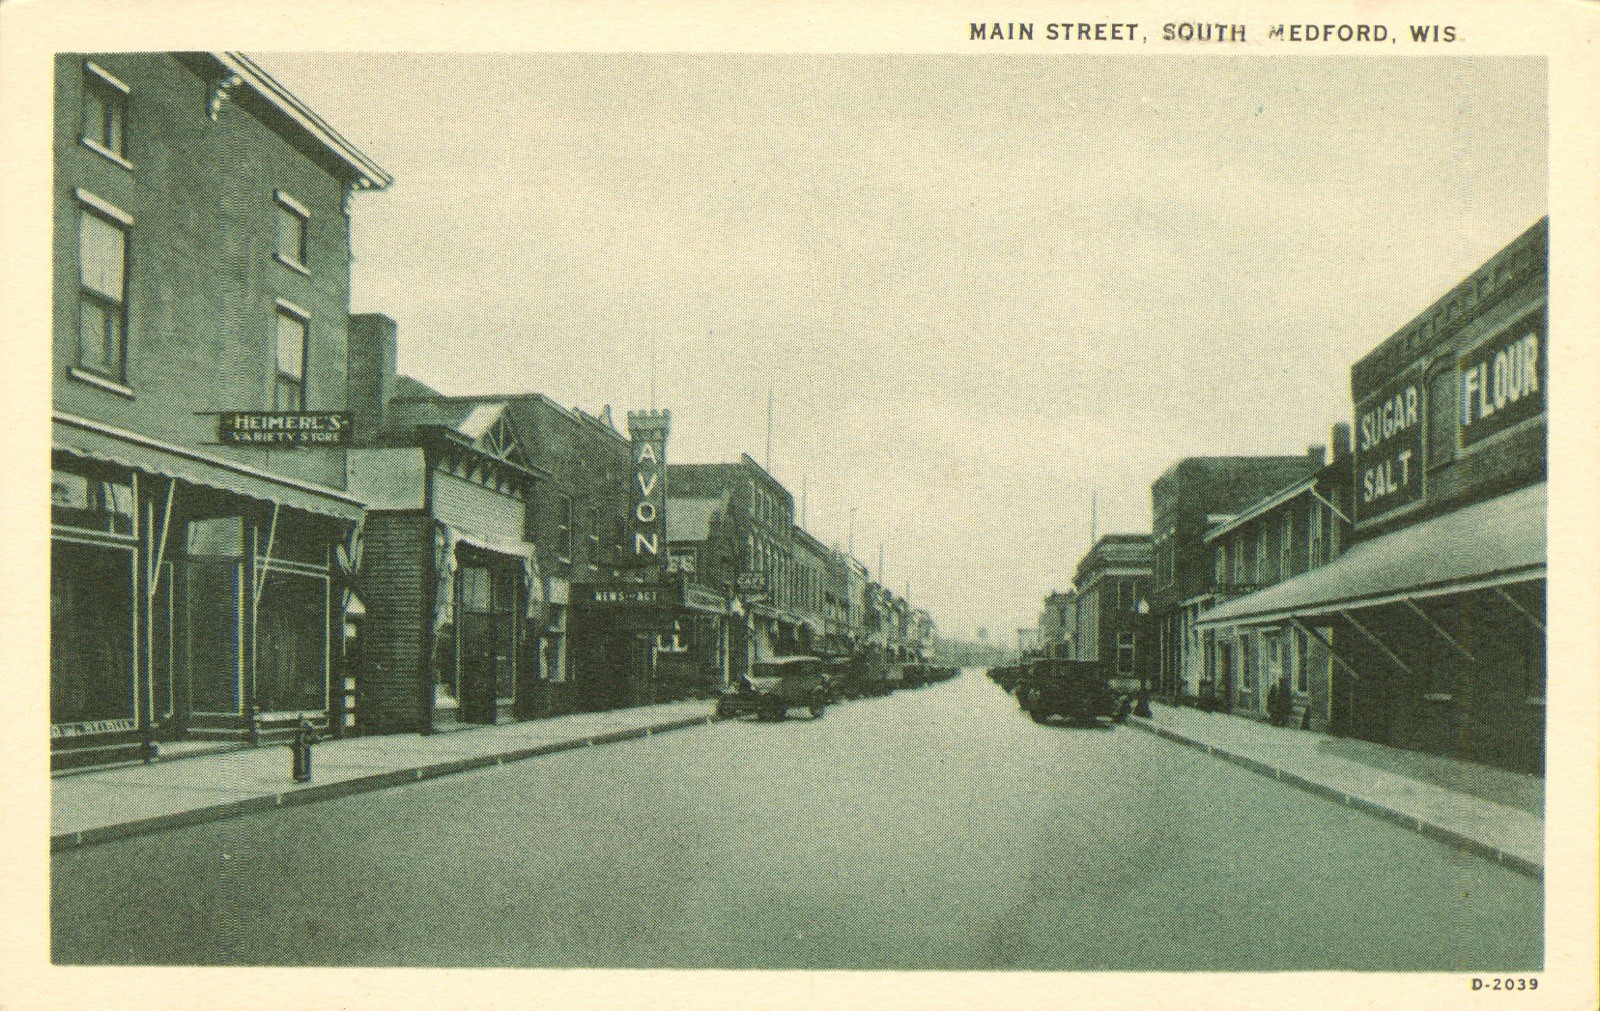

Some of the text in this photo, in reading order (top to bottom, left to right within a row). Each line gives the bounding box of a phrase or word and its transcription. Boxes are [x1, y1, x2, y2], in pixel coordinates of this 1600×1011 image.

[1464, 332, 1539, 427] FLOUR
[232, 431, 340, 443] VARIETY STORE
[1361, 386, 1418, 451] SUGAR
[636, 443, 658, 555] AVON
[1363, 449, 1412, 502] SALT
